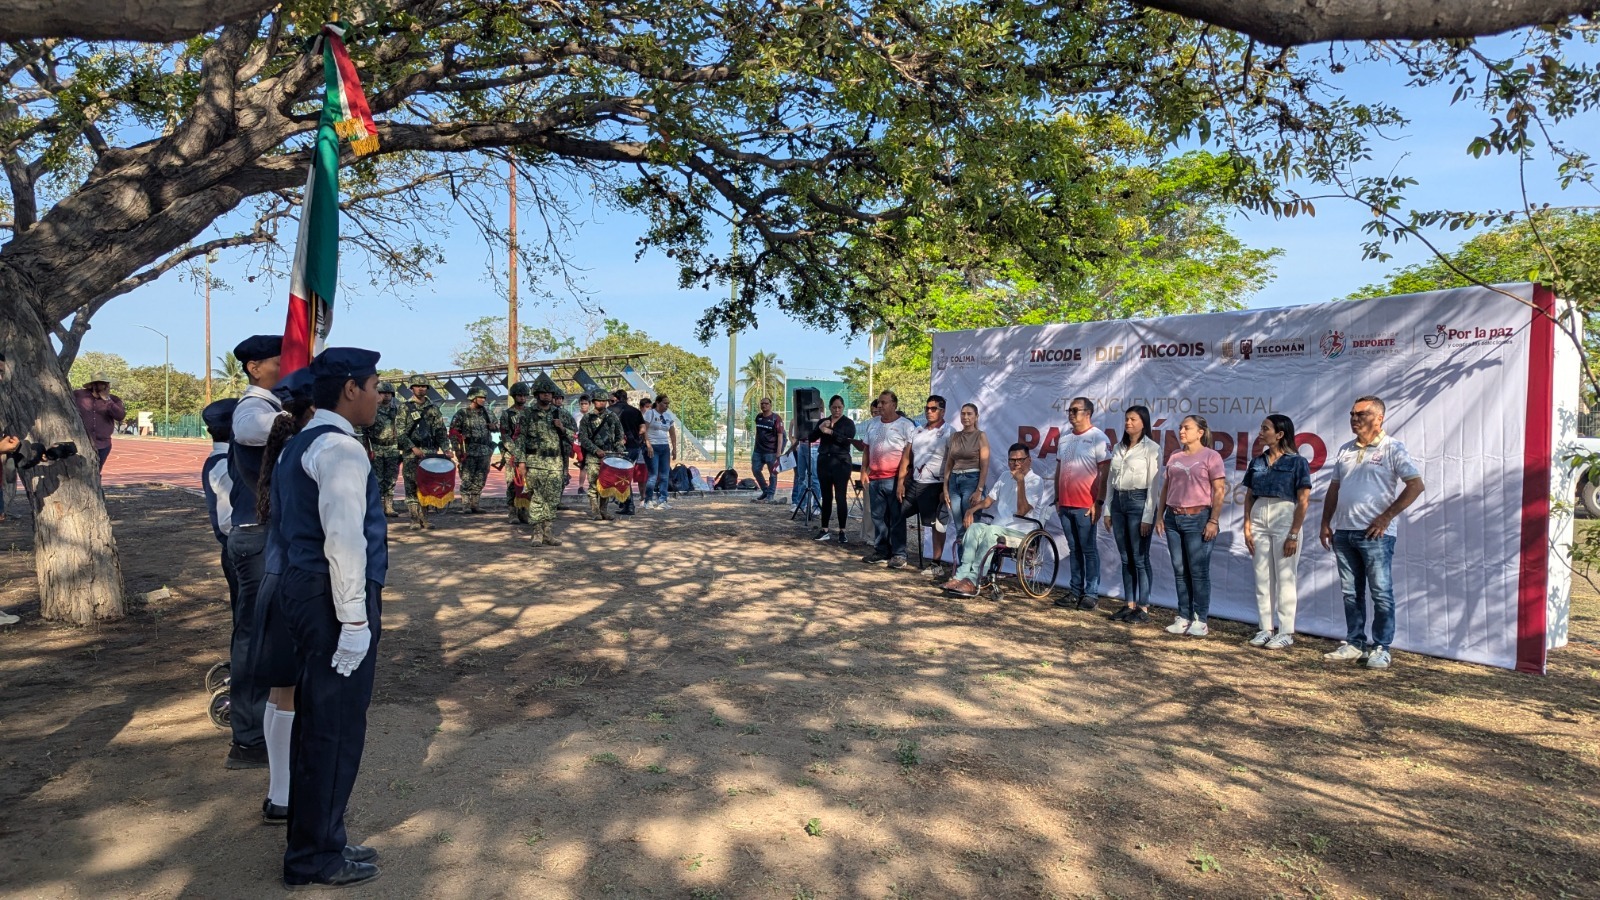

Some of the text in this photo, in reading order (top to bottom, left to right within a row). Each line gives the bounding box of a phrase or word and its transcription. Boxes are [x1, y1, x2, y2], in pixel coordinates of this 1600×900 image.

[1448, 326, 1513, 341] Por la paz
[1140, 342, 1205, 359] INCODIS
[1257, 343, 1305, 354] TECOMÁN
[1352, 338, 1396, 349] DEPORTE
[951, 355, 976, 363] COLIMA
[1030, 348, 1082, 363] INCODE
[1095, 346, 1124, 362] DIF
[1198, 396, 1280, 414] ESTATAL
